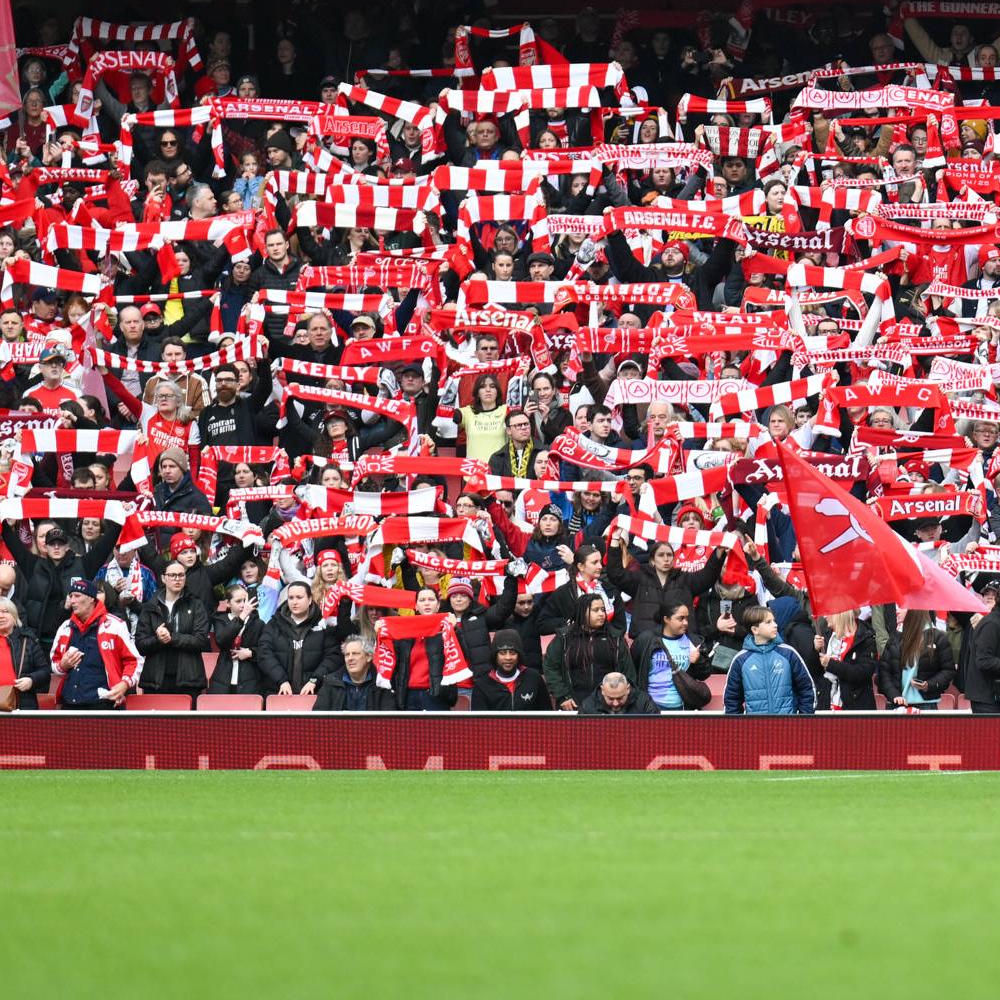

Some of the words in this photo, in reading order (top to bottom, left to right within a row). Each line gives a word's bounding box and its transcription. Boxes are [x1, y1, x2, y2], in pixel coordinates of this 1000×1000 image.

[908, 1, 935, 14] THE
[226, 102, 315, 117] ARSENAL
[38, 167, 101, 181] Arsenal
[947, 160, 995, 174] rsenal
[624, 210, 689, 228] ARSENAL
[574, 282, 675, 296] FOREVER
[766, 289, 838, 303] ARENAL
[926, 281, 995, 299] SUPPORTERS
[454, 308, 535, 331] Arsenal
[693, 311, 762, 325] MEAD
[359, 339, 433, 359] AWFC
[291, 359, 372, 381] KELLY
[949, 399, 984, 411] ENAL
[150, 428, 186, 445] Emirates
[890, 494, 960, 516] Arsenal
[137, 511, 175, 524] LESSIA
[179, 512, 218, 527] RUSSO
[414, 551, 496, 571] McCABE
